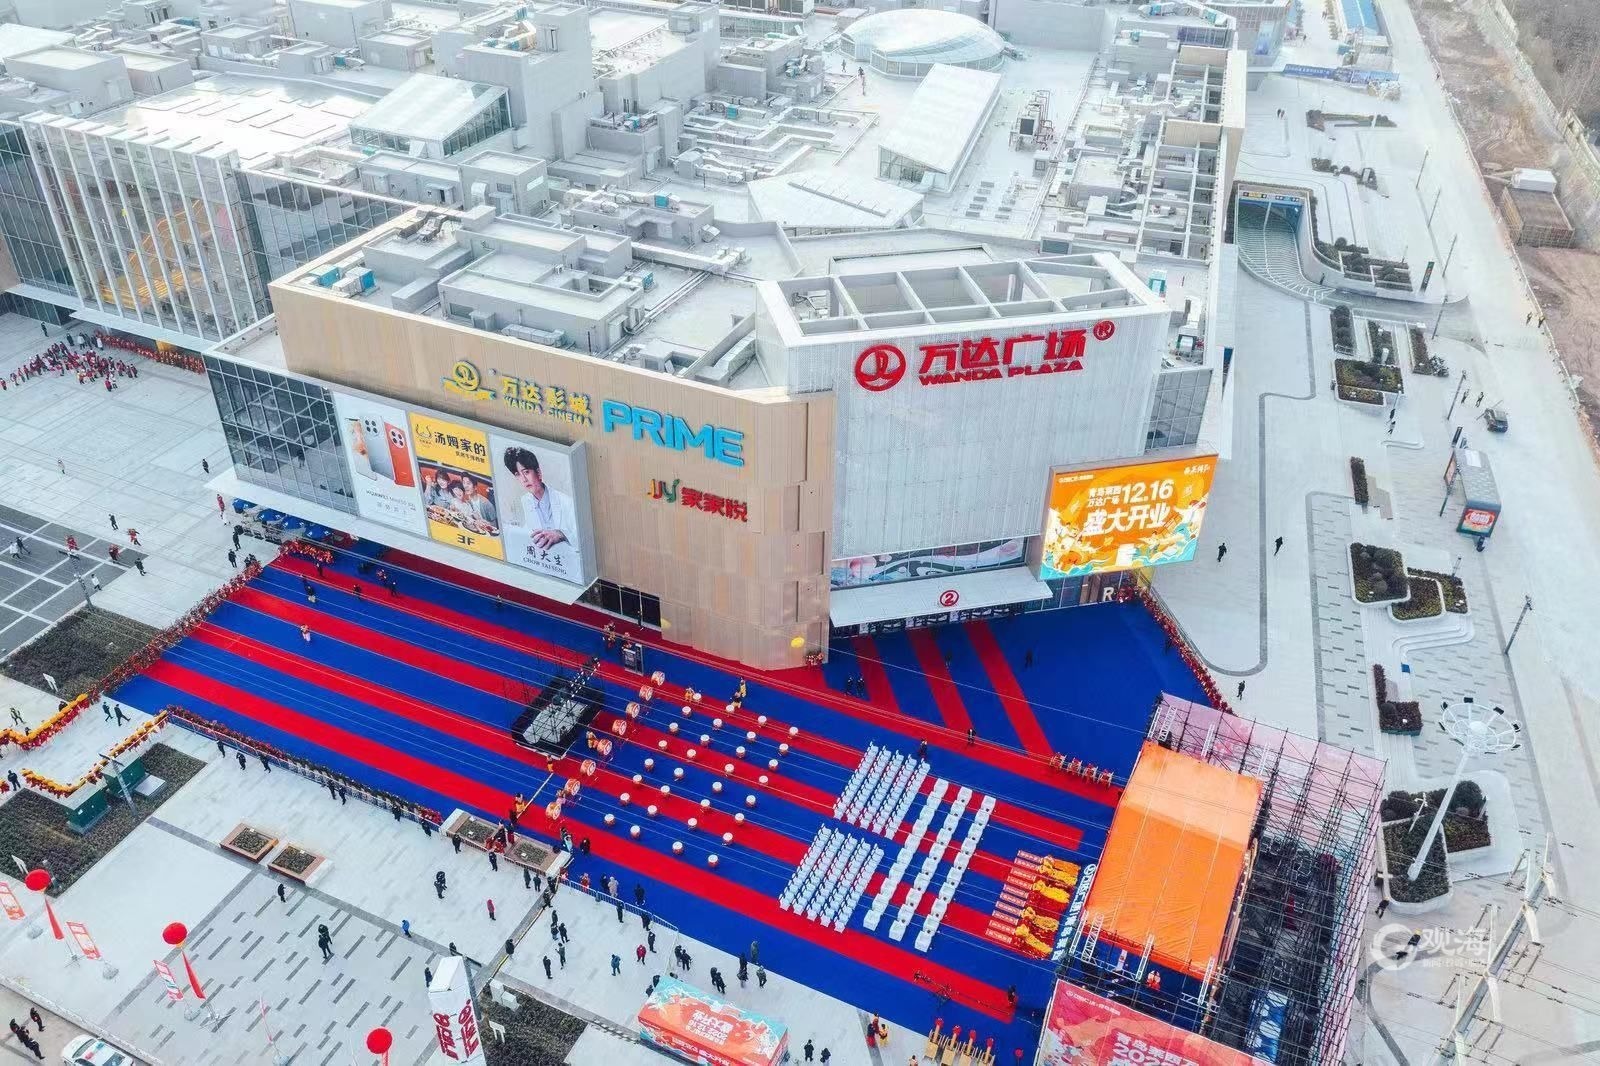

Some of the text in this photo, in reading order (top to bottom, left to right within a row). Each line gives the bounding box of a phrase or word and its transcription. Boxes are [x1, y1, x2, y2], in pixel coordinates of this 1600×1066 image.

[918, 328, 1087, 374] 万达广场
[918, 359, 1084, 387] WANDA PLAZA
[501, 375, 592, 416] 万达影城
[549, 407, 593, 427] CINEMA
[434, 431, 486, 457] 汤姆家的
[602, 400, 745, 468] PRIME
[681, 486, 748, 523] 家家悦
[1122, 479, 1174, 504] 12.16
[1082, 502, 1170, 537] 盛大开业
[526, 545, 563, 567] 周大生
